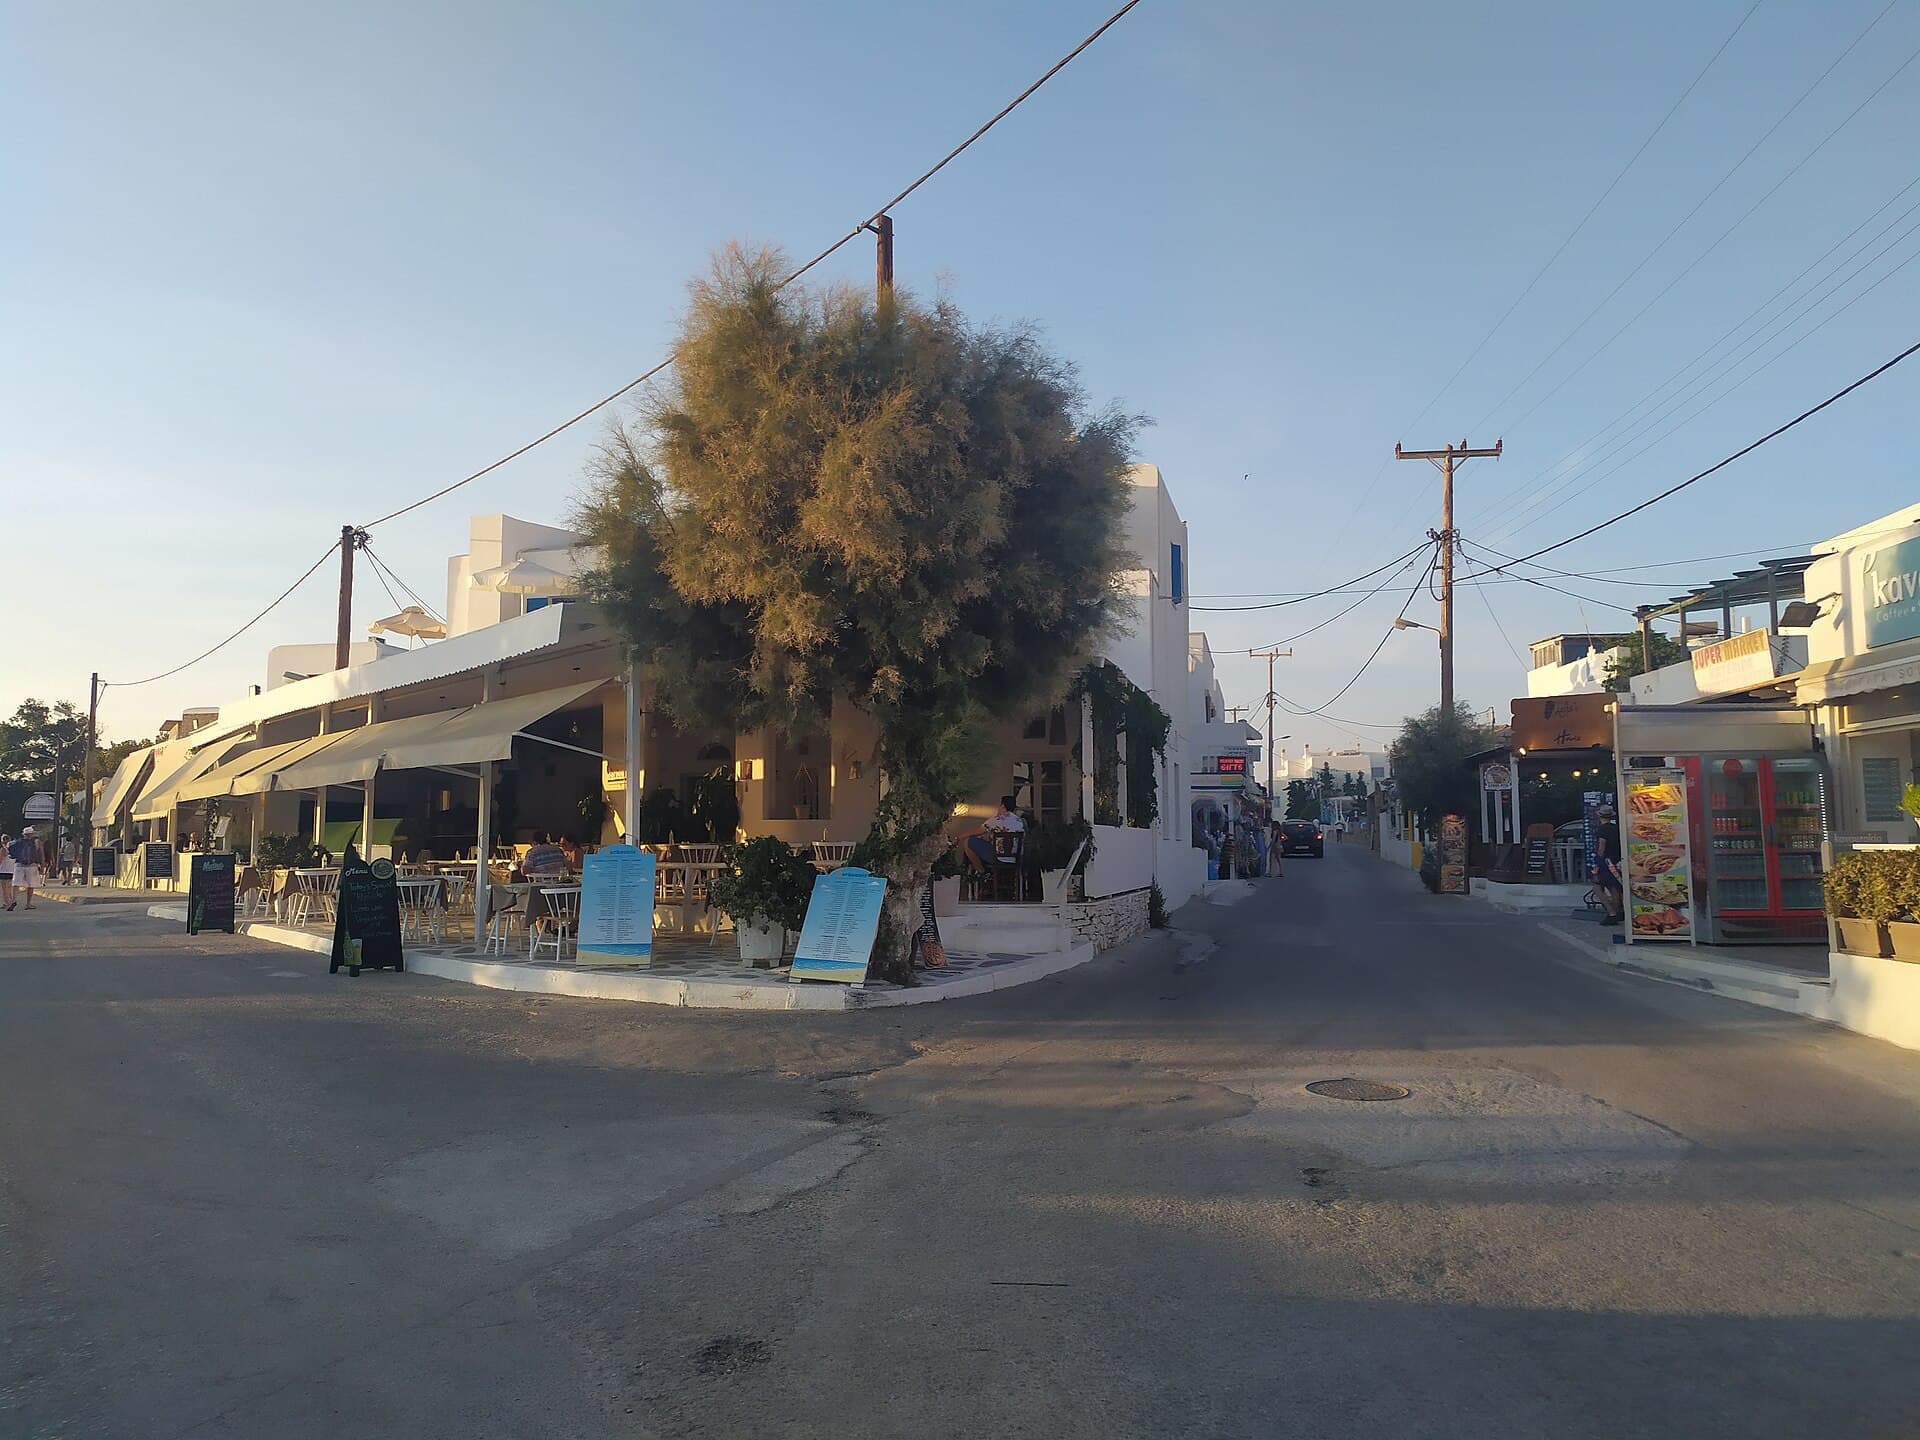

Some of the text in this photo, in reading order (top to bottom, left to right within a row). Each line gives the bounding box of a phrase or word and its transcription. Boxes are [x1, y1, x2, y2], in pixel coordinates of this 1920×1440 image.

[1871, 570, 1920, 608] kav
[1694, 644, 1723, 670] SUPER
[1723, 631, 1766, 662] MARKET
[345, 867, 369, 877] Menu
